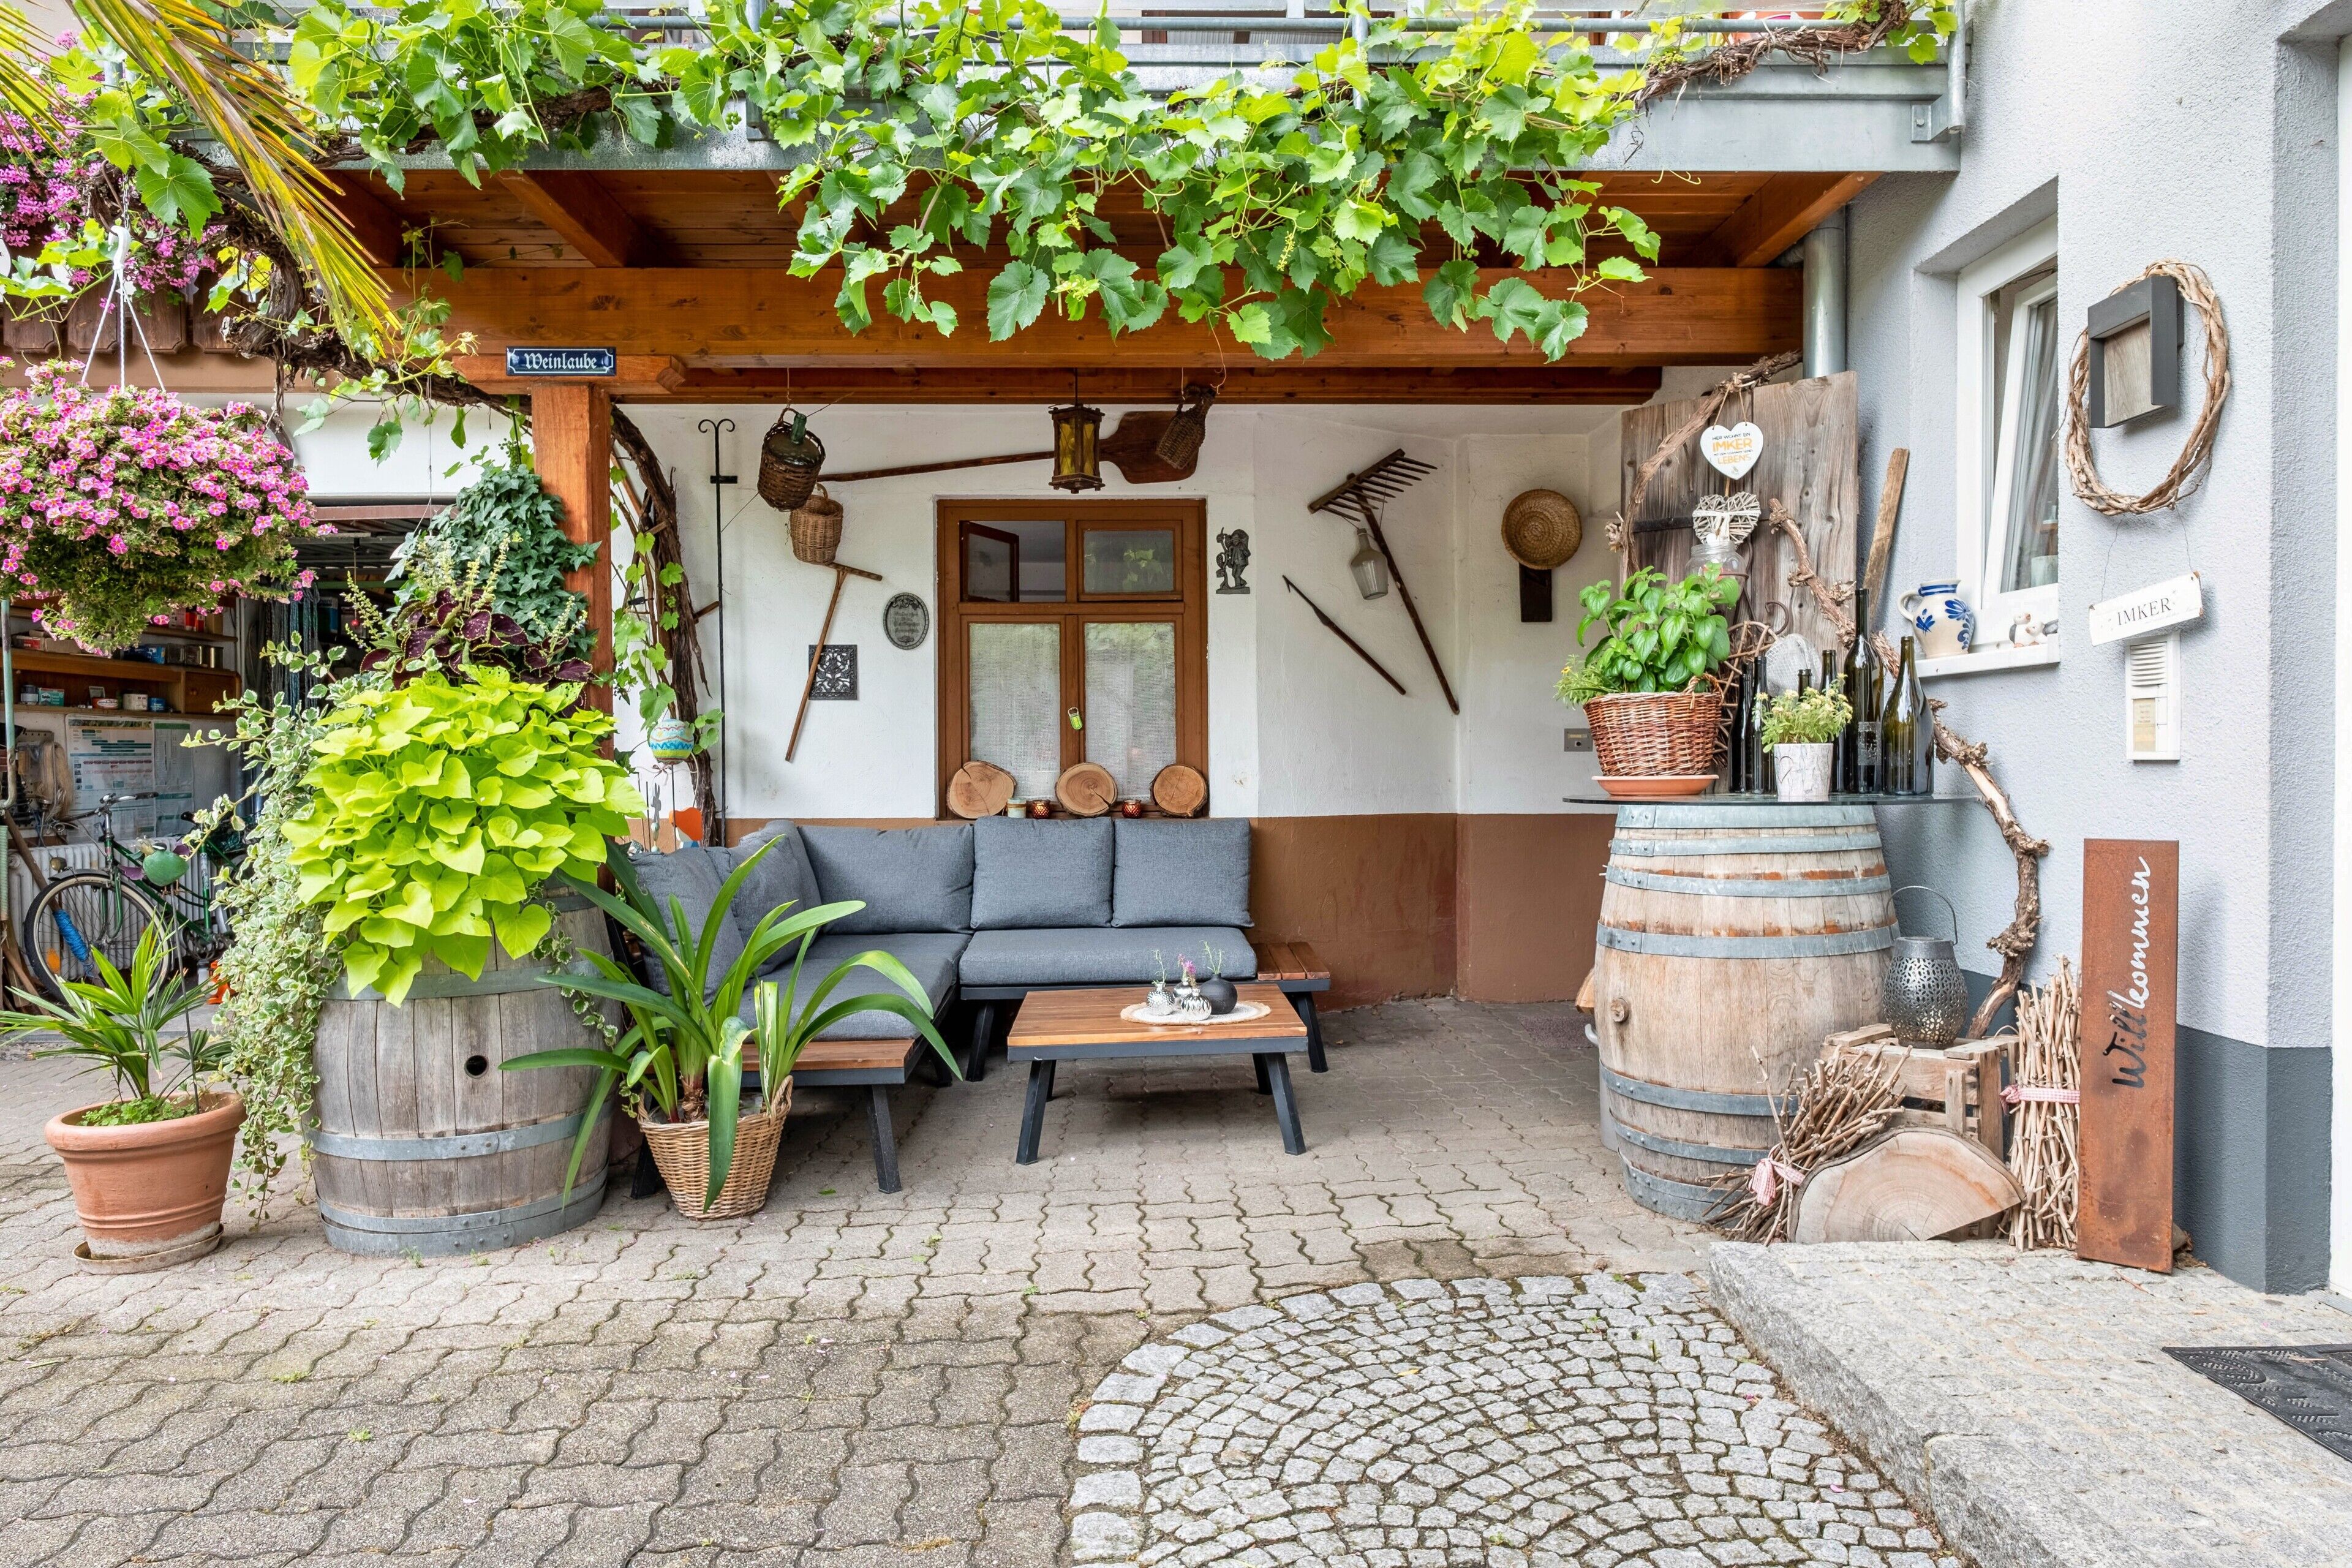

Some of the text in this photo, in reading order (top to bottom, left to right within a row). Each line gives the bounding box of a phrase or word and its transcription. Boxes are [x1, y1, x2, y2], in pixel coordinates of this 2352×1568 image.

[524, 353, 597, 369] Weinlaube
[1713, 438, 1752, 452] IMKER
[1717, 454, 1752, 464] LEBENS
[2117, 597, 2171, 625] IMKER
[2103, 856, 2151, 1088] Willkommen
